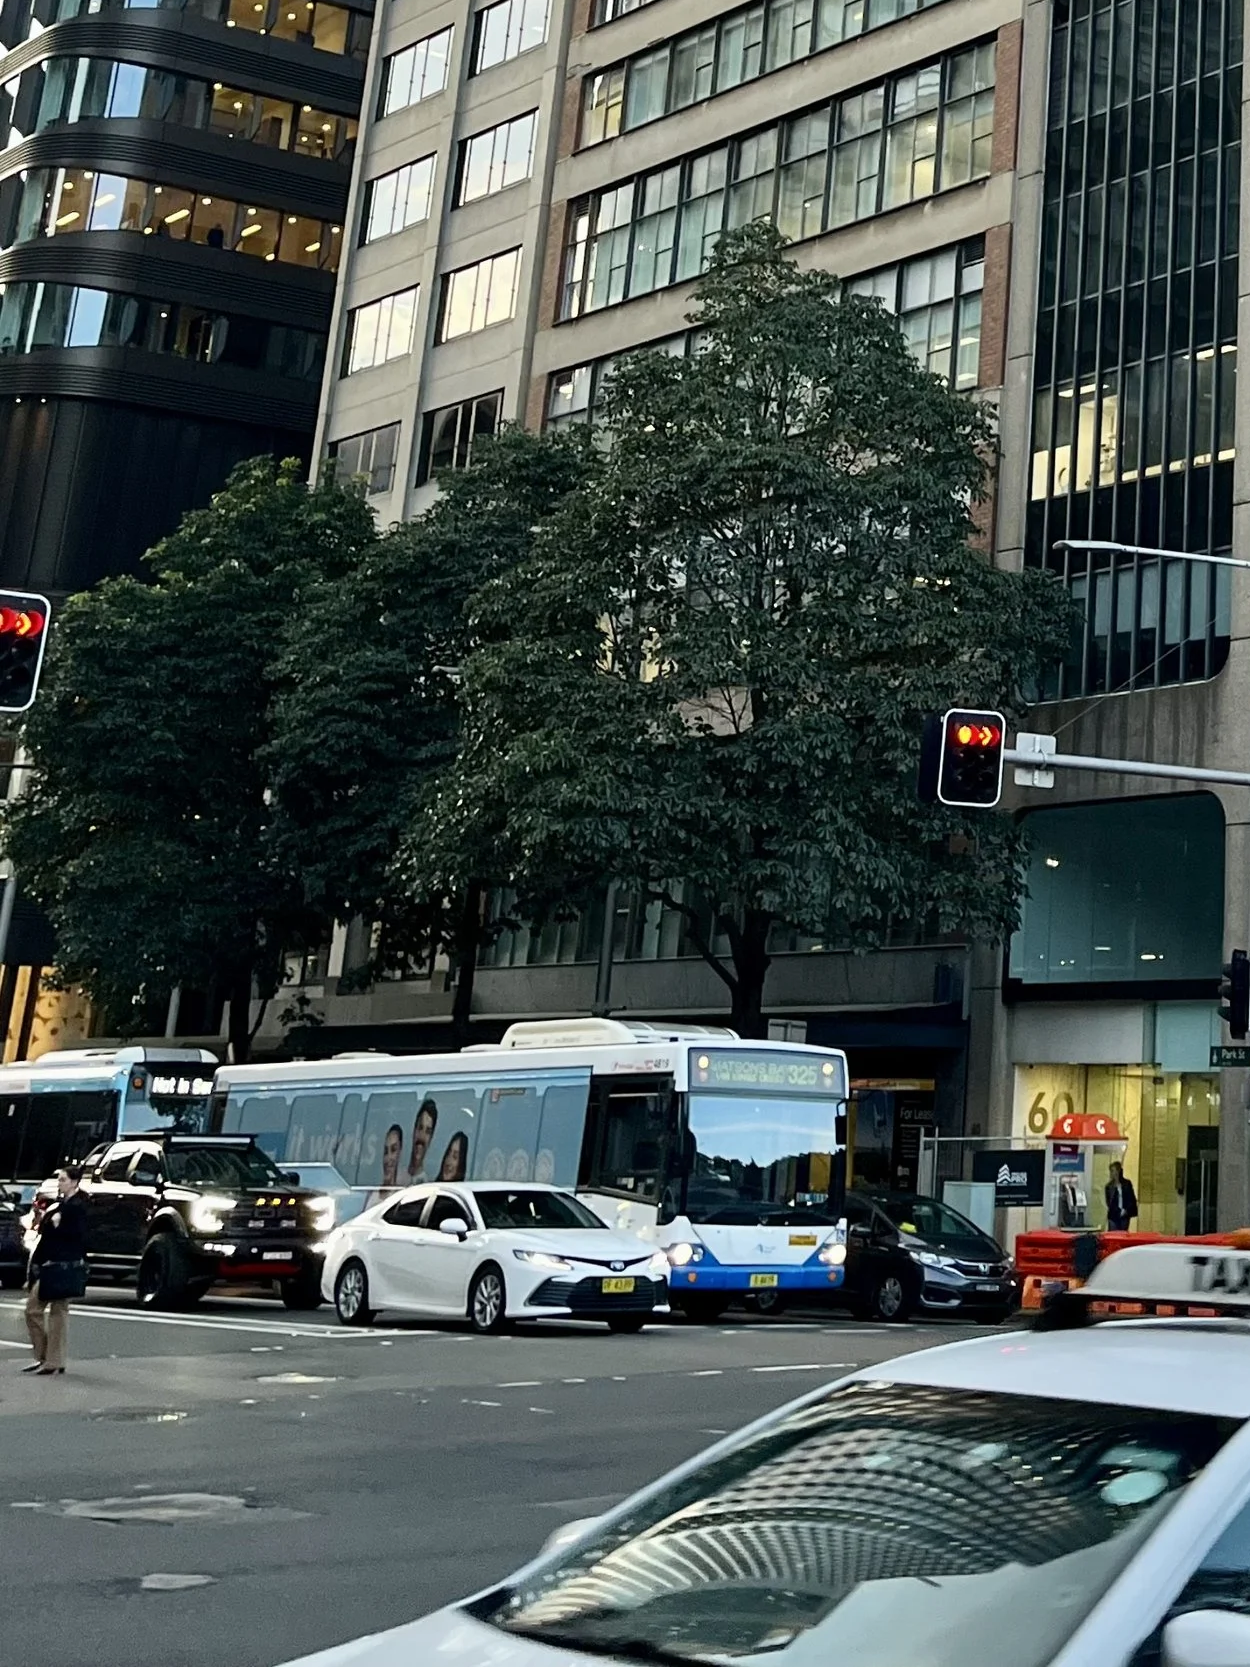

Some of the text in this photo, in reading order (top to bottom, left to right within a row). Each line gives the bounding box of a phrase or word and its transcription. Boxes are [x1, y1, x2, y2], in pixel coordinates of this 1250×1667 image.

[1221, 1048, 1246, 1060] Park St
[787, 1064, 818, 1085] 325
[1028, 1092, 1075, 1134] 60
